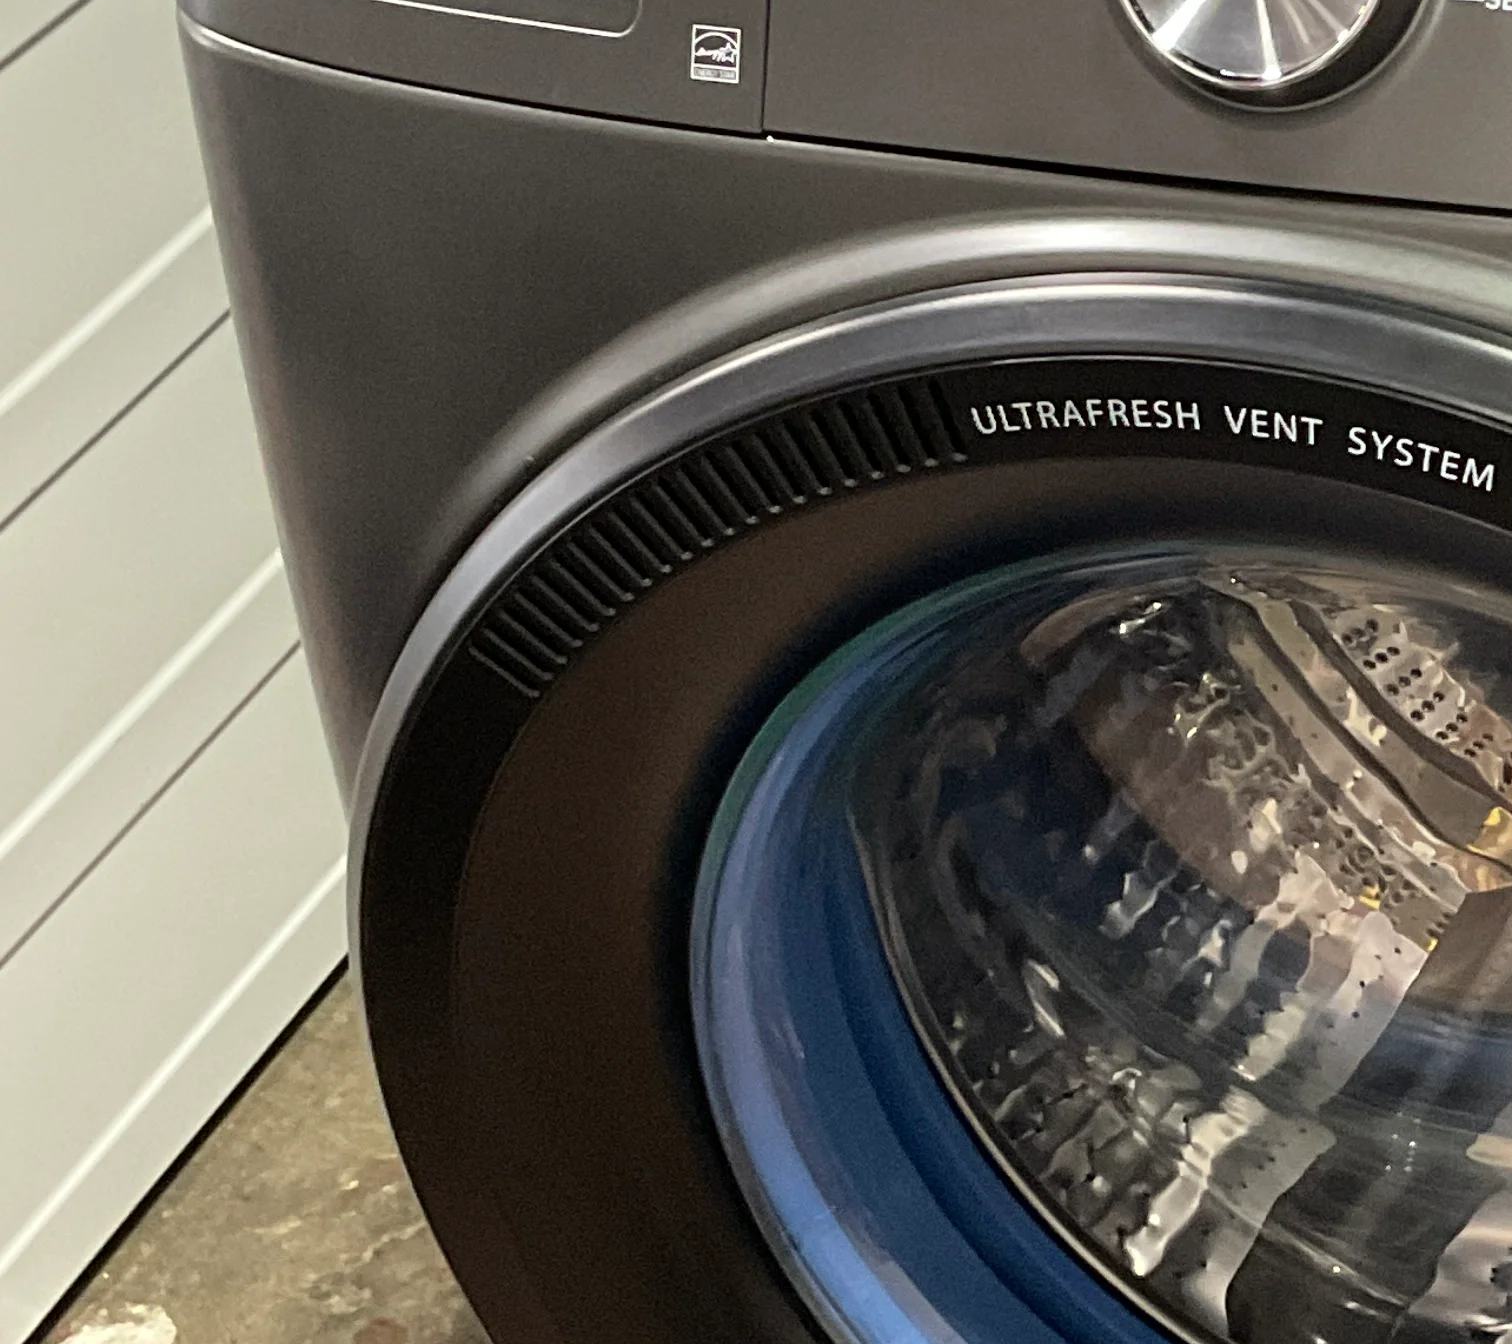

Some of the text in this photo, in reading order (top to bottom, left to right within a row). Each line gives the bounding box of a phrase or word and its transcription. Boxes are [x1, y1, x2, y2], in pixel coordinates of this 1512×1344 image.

[970, 399, 1497, 493] ULTRAFRESH VENT SYSTEM
